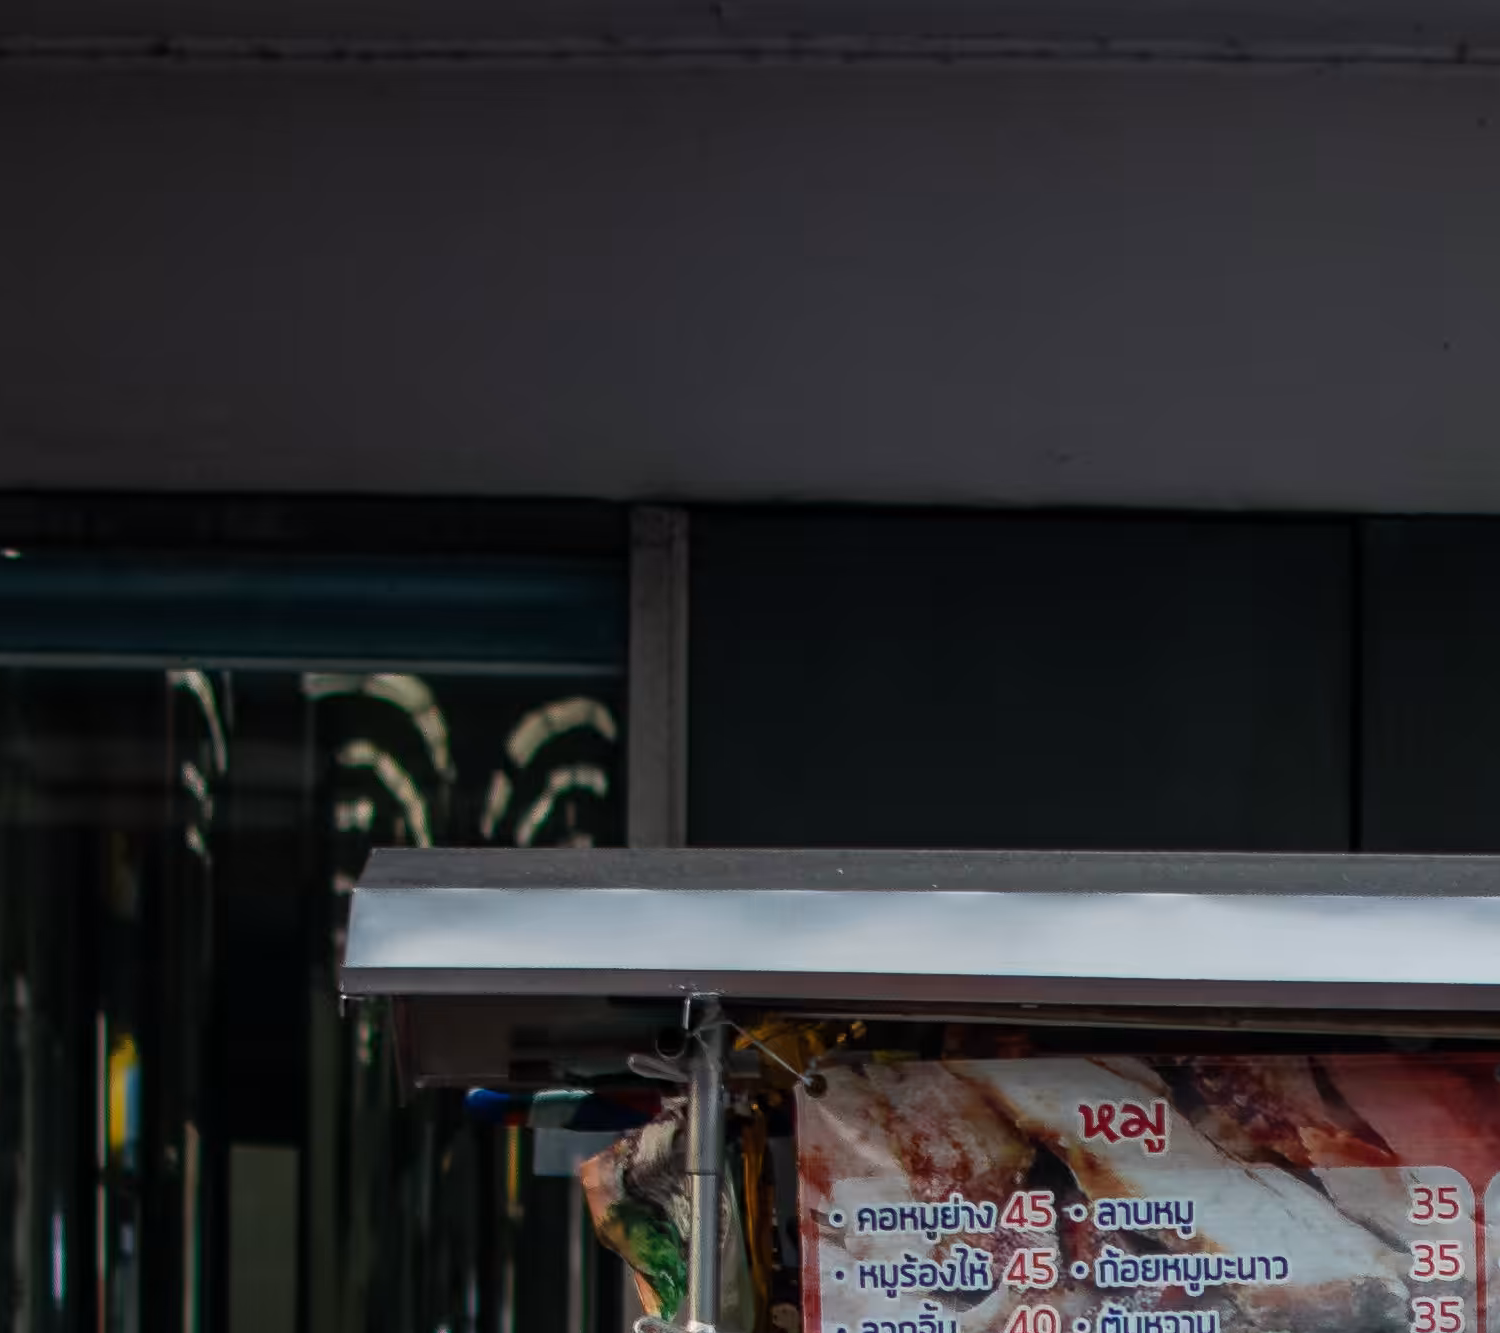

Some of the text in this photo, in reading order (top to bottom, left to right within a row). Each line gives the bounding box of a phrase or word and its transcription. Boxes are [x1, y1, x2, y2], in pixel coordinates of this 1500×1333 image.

[1079, 1101, 1167, 1153] หมู
[856, 1193, 1054, 1240] คอหมูย่าง 45
[1097, 1186, 1461, 1235] ลาบหมู 35
[859, 1248, 1056, 1298] หมูร้องไห้ 45
[1098, 1243, 1462, 1292] ก้อยหมูมะนาว 35
